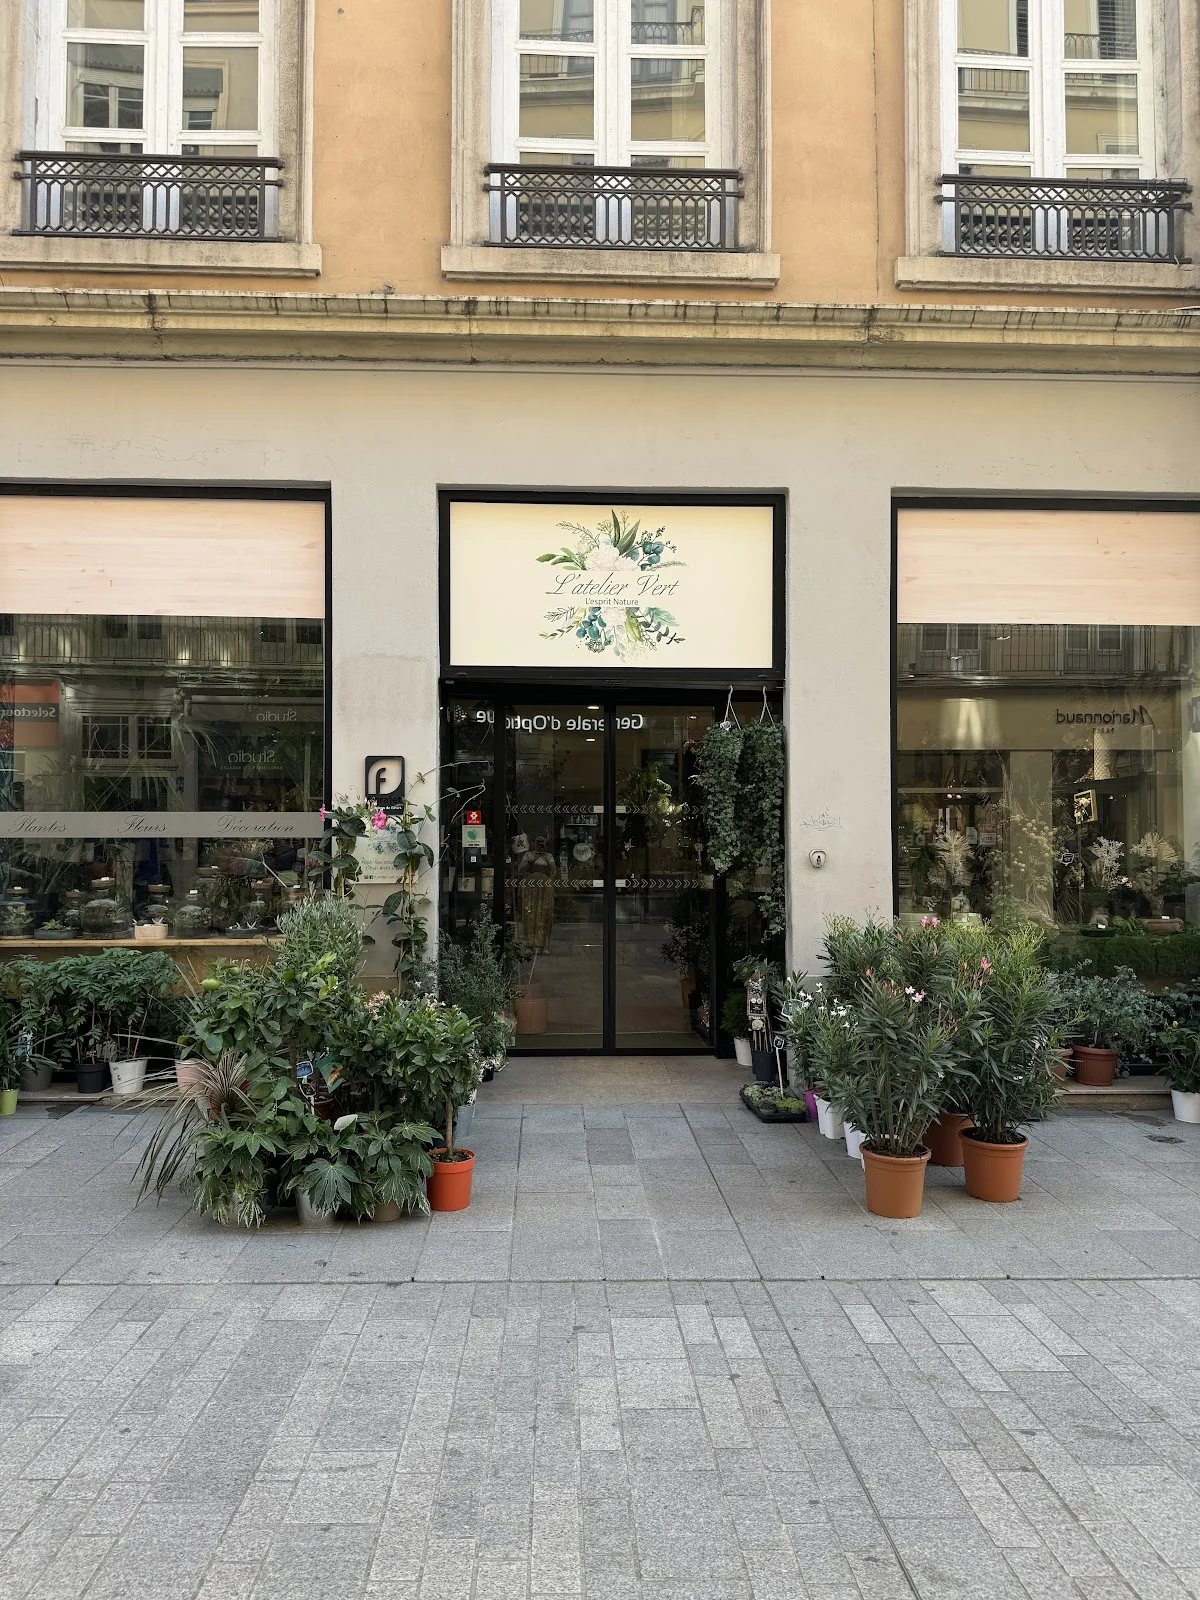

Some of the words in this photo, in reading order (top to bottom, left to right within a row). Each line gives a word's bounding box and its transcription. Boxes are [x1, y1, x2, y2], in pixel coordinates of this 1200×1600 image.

[545, 572, 629, 595] L'atelier
[636, 573, 680, 596] Vert
[585, 598, 611, 606] L'esprit
[613, 598, 639, 606] Nature
[8, 815, 67, 833] Plantes
[117, 815, 168, 833] Fleurs
[213, 815, 296, 833] Décoration
